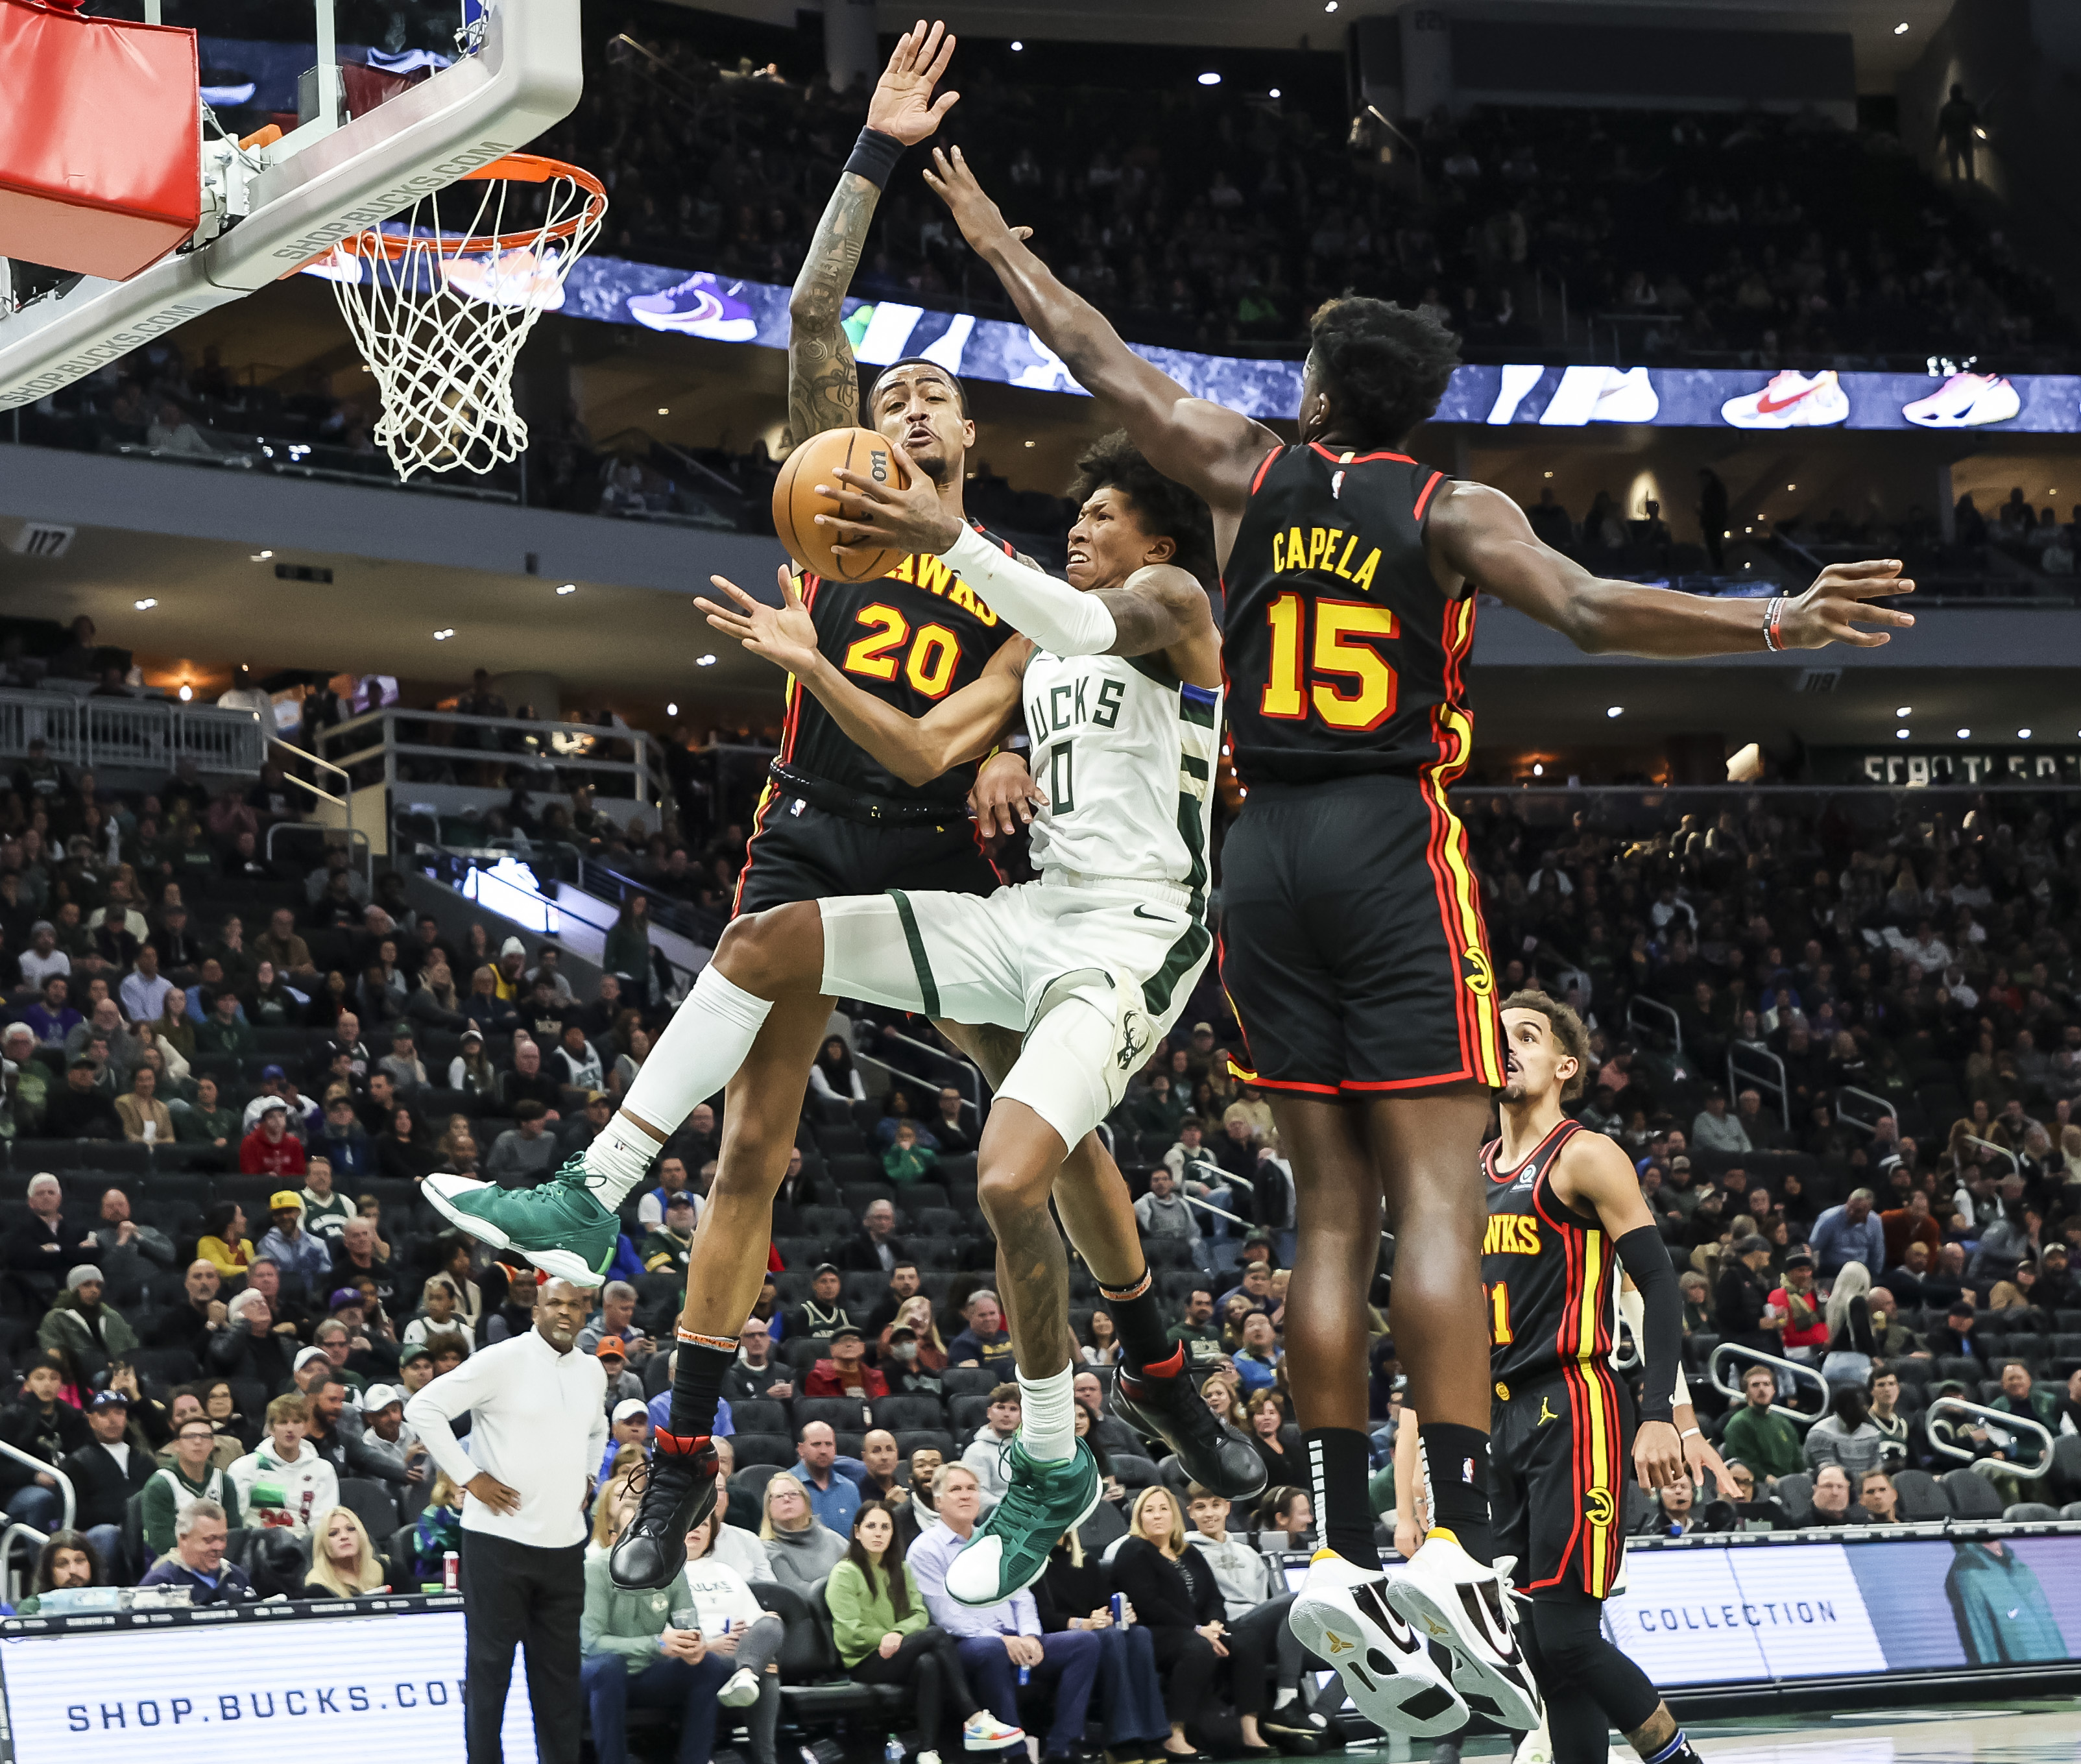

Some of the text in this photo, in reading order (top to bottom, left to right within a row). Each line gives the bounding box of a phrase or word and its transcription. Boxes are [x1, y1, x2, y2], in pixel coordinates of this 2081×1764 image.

[272, 141, 514, 260] SHOP.BUCKS.COM
[1, 304, 202, 402] SHOP.BUCKS.COM
[27, 530, 66, 553] 117
[1273, 527, 1382, 591] CAPELA
[884, 553, 999, 627] AWKS
[843, 601, 962, 699] 20
[1259, 590, 1401, 732] 15
[1030, 675, 1126, 746] UCKS
[1051, 739, 1075, 817] 0
[1482, 1281, 1514, 1345] 1
[1639, 1600, 1837, 1632] COLLECTION
[67, 1679, 465, 1732] SHOP.BUCKS.CO
